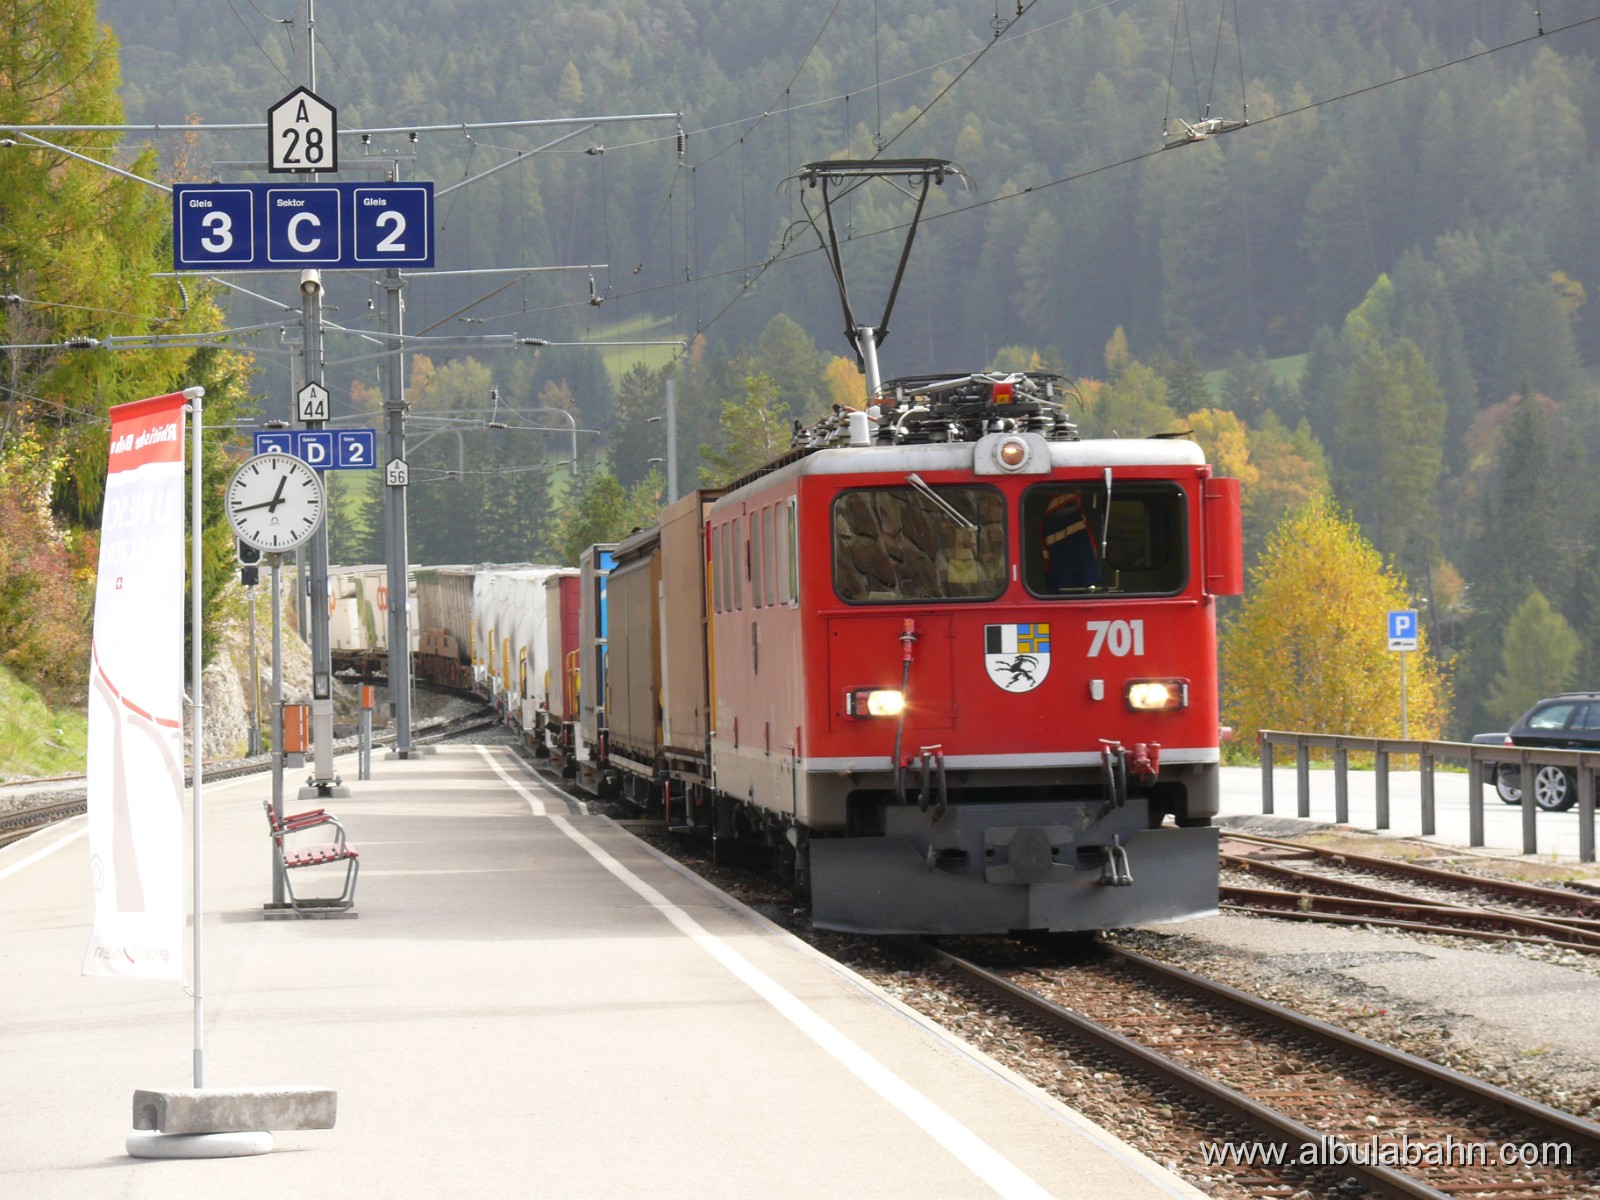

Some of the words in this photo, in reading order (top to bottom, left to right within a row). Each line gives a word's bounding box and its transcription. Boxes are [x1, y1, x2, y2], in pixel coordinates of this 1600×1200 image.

[295, 99, 310, 123] A
[281, 127, 324, 164] 28
[189, 199, 213, 208] Gleis
[276, 198, 305, 207] Sektor
[363, 197, 387, 206] Gleis
[201, 211, 234, 253] 3
[287, 212, 322, 253] C
[375, 210, 407, 252] 2
[310, 387, 317, 399] A
[303, 400, 325, 418] 44
[307, 442, 326, 463] D
[348, 442, 364, 462] 2
[394, 461, 400, 470] A
[389, 470, 406, 484] 56
[1395, 615, 1410, 636] P
[1086, 619, 1145, 658] 701
